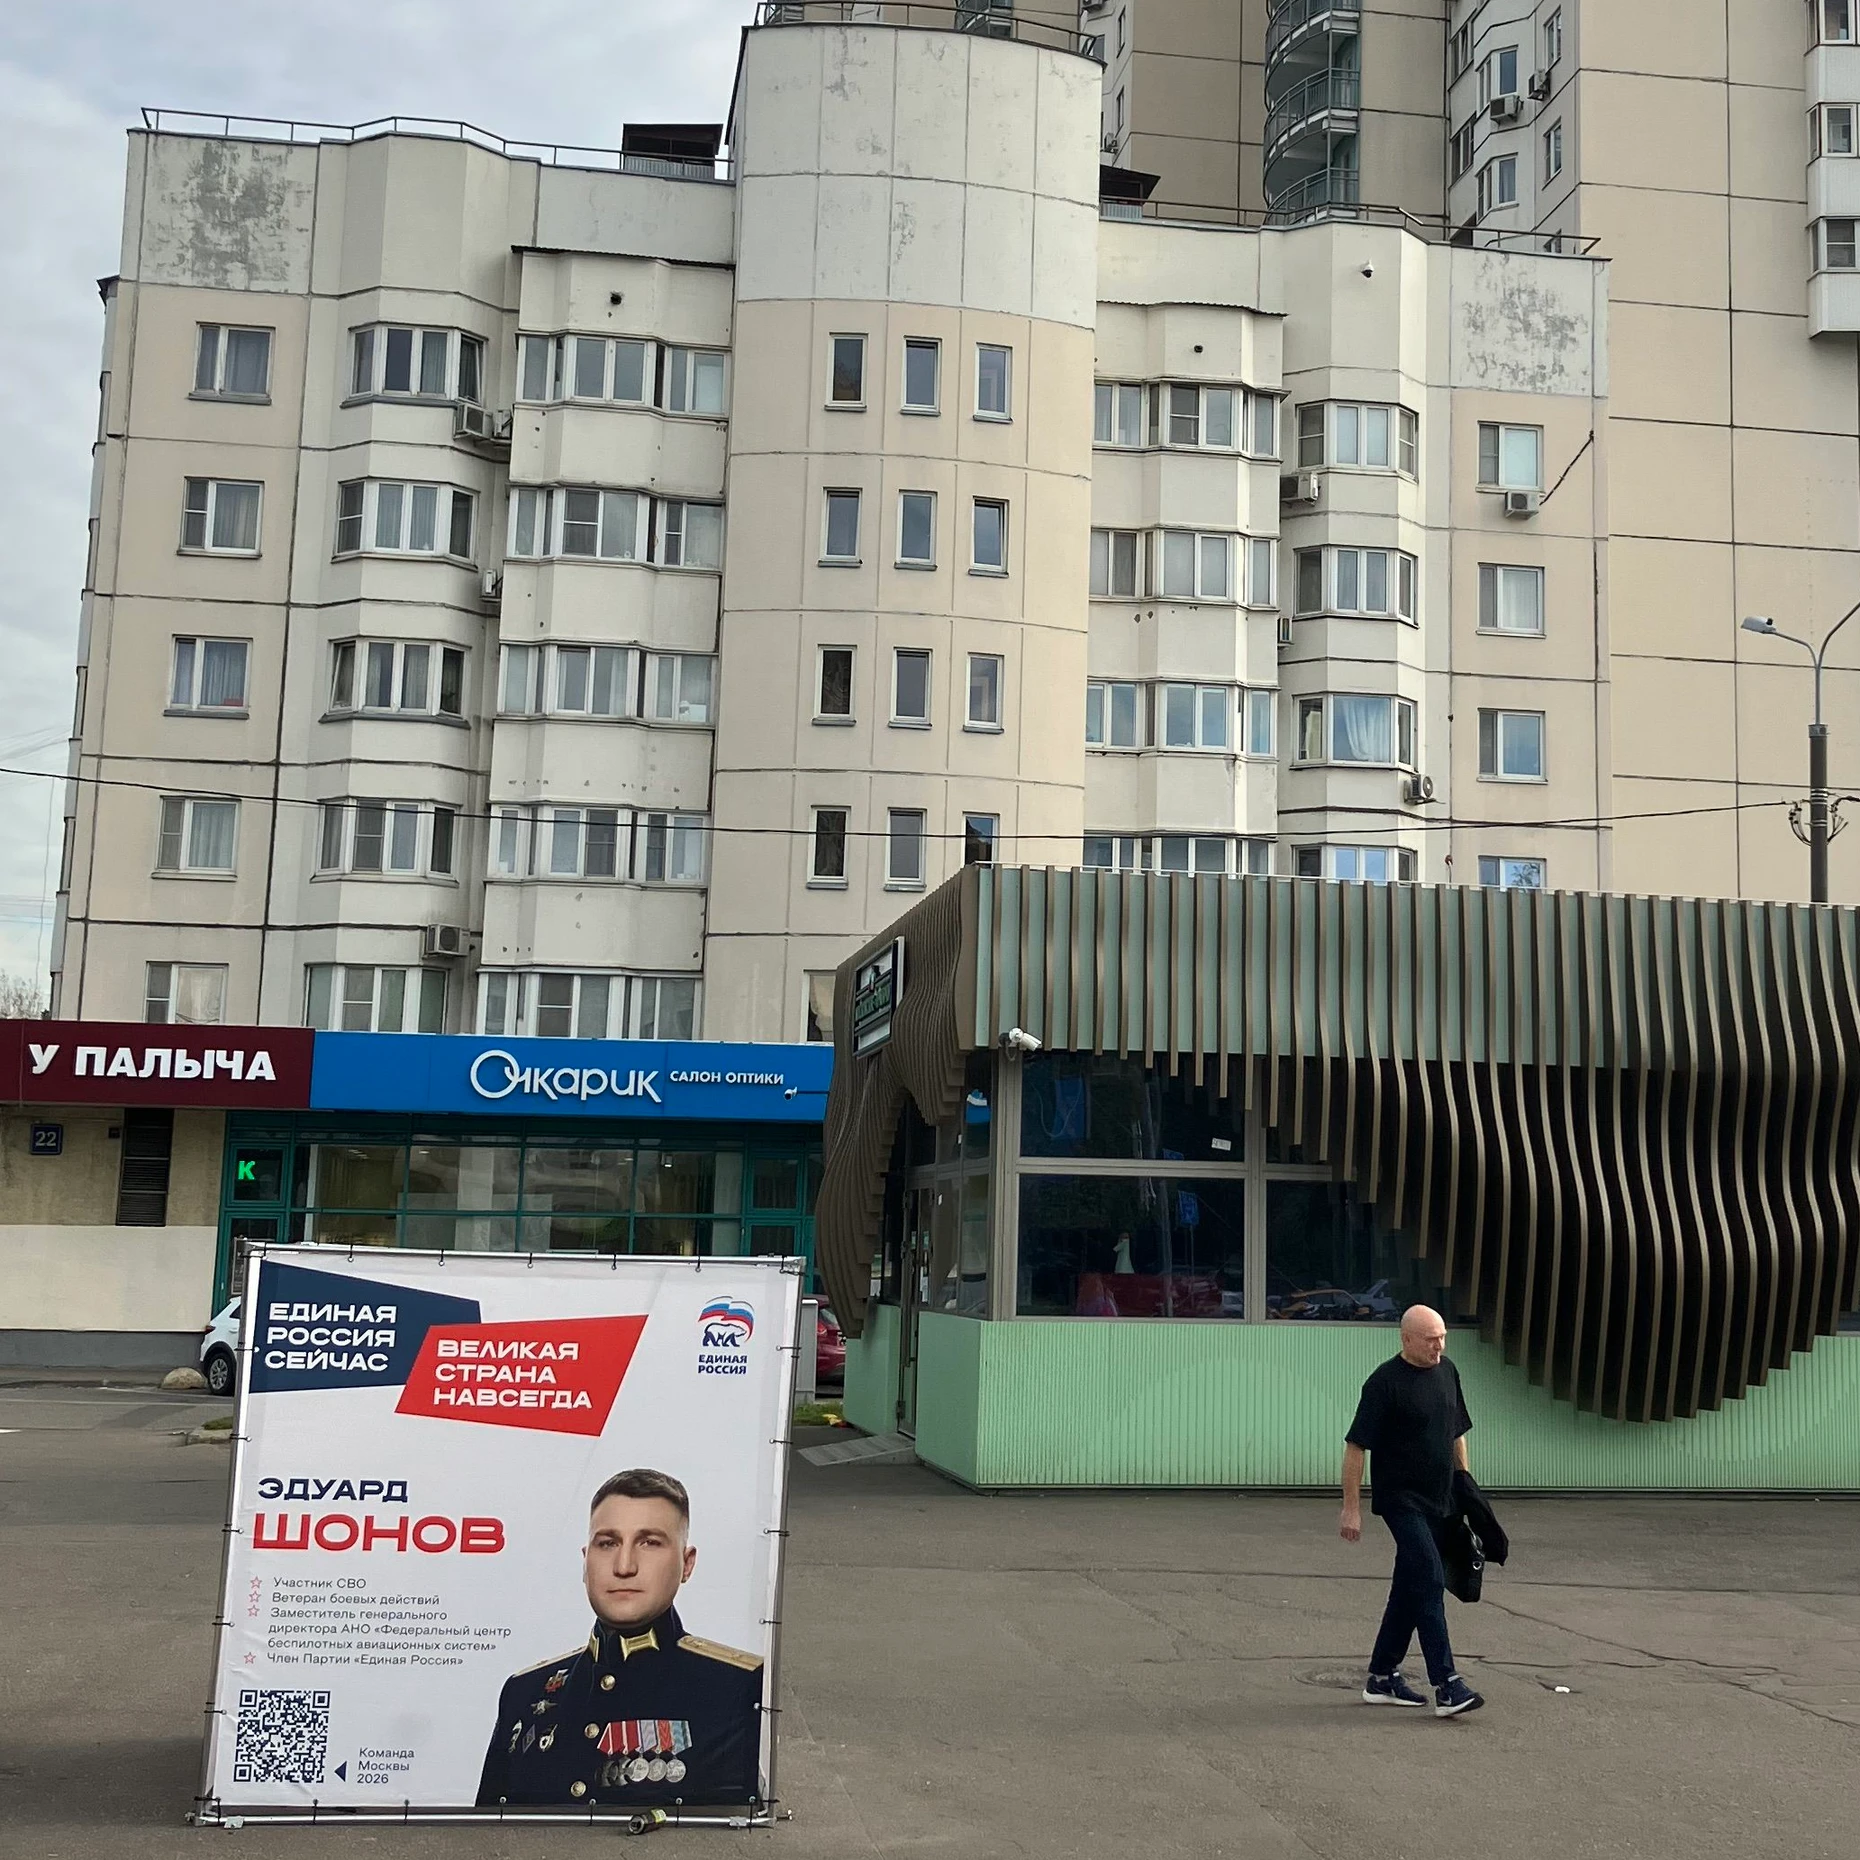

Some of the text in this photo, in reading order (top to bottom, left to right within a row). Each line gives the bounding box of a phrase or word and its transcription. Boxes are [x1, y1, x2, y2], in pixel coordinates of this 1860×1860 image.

[28, 1043, 277, 1081] У ПАЛЫЧА
[470, 1049, 662, 1103] Очкарик
[669, 1070, 784, 1085] САЛОН ОПТИКИ
[35, 1131, 57, 1147] 22
[268, 1302, 397, 1323] ЕДИНАЯ
[266, 1326, 396, 1348] РОССИЯ
[436, 1339, 579, 1361] ВЕЛИКАЯ
[264, 1348, 389, 1372] СЕЙЧАС
[698, 1354, 748, 1364] ЕДИНАЯ
[434, 1363, 557, 1384] СТРАНА
[697, 1364, 747, 1375] РОССИЯ
[432, 1387, 593, 1409] НАВСЕГДА
[257, 1477, 408, 1503] ЭДУАРД
[252, 1512, 506, 1554] ШОНОВ
[272, 1577, 367, 1590] Участник СВО
[271, 1592, 440, 1606] Ветеран боевых действий
[270, 1607, 447, 1621] Заместитель генерального
[267, 1624, 512, 1638] директора АНО «Федеральный центр
[267, 1637, 497, 1652] беспилотных авиационных систем»
[266, 1653, 464, 1667] Член Партии «Единая Россия»
[359, 1747, 415, 1759] Команда
[358, 1760, 410, 1771] Москвы
[357, 1773, 389, 1784] 2026
